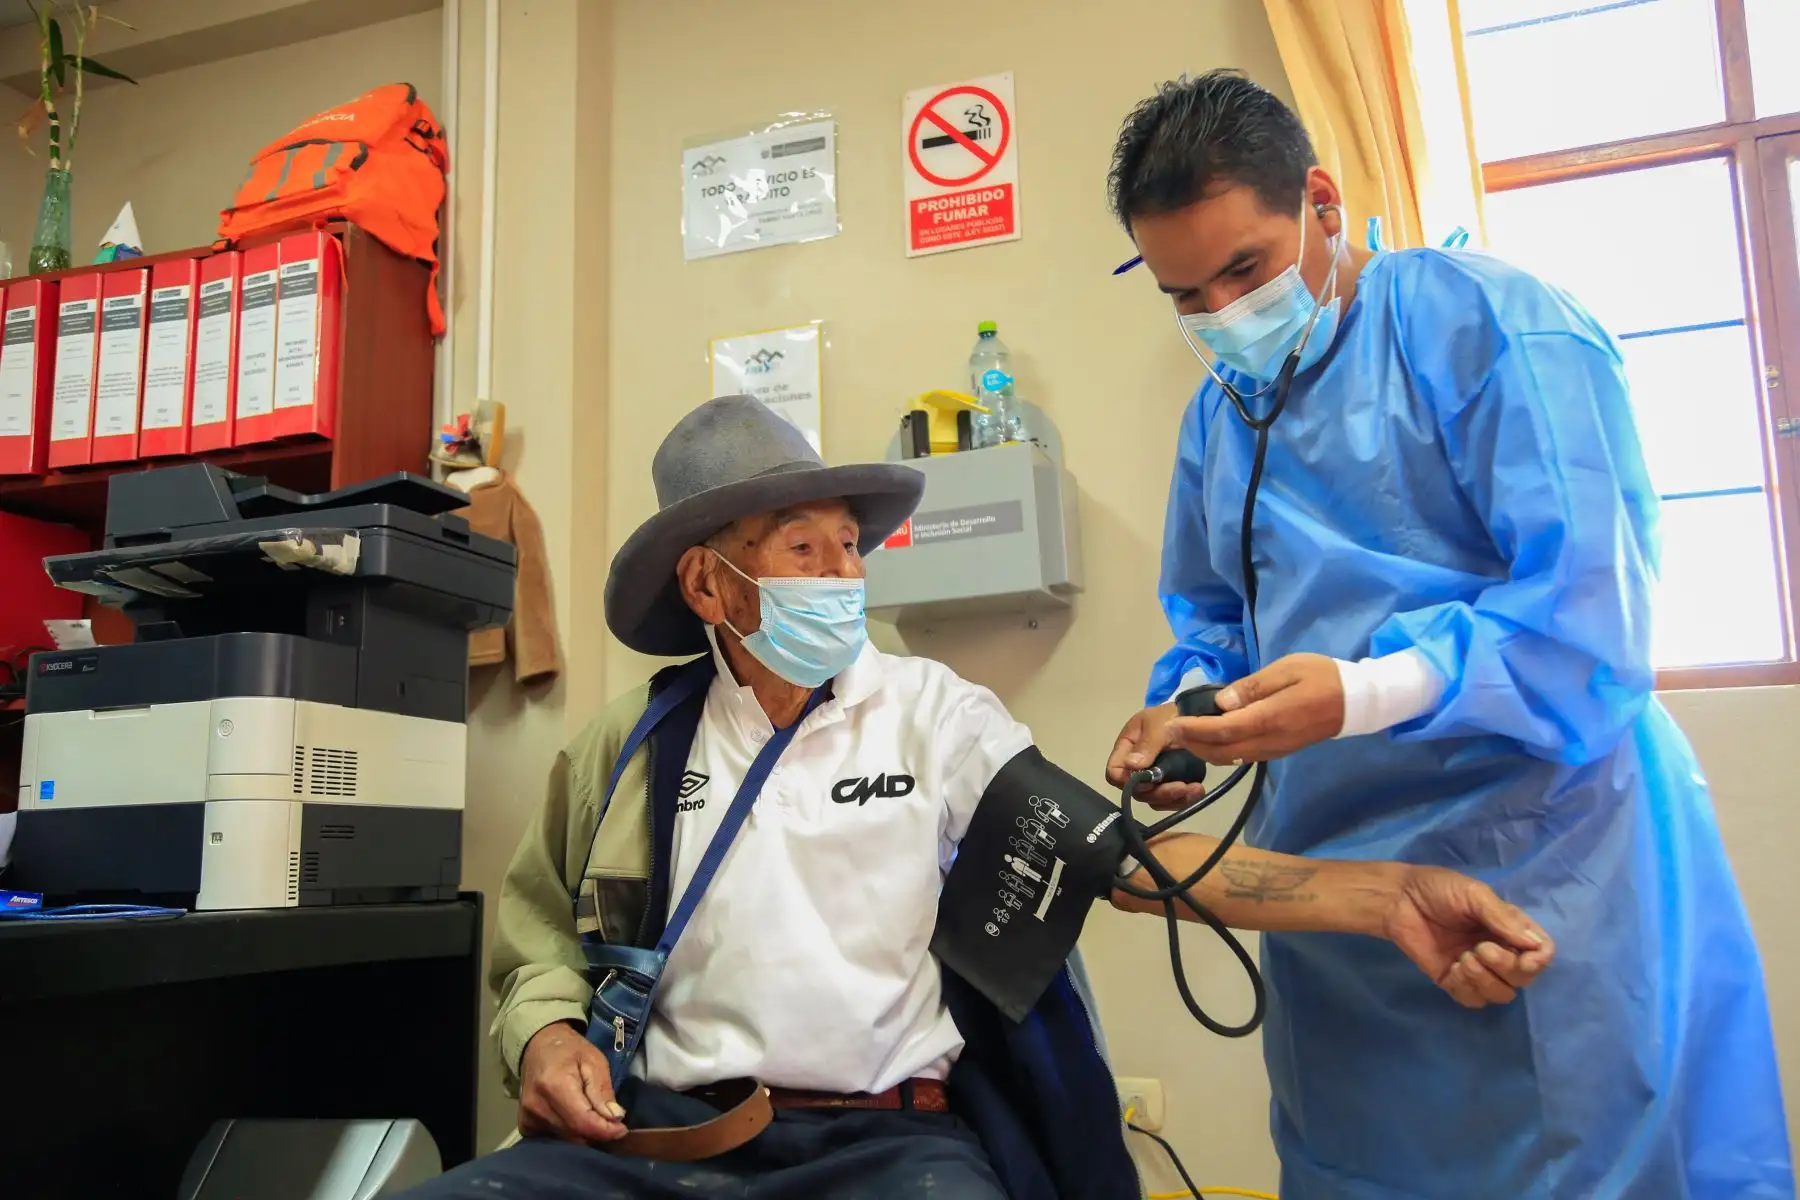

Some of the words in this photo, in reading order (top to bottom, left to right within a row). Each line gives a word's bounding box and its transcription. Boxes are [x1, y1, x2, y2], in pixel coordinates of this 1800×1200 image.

[802, 167, 816, 179] ES
[917, 189, 1004, 213] PROHIBIDO
[933, 205, 989, 224] FUMAR
[960, 515, 996, 527] Desarrollo
[831, 772, 916, 807] CMD
[676, 798, 705, 813] mbro
